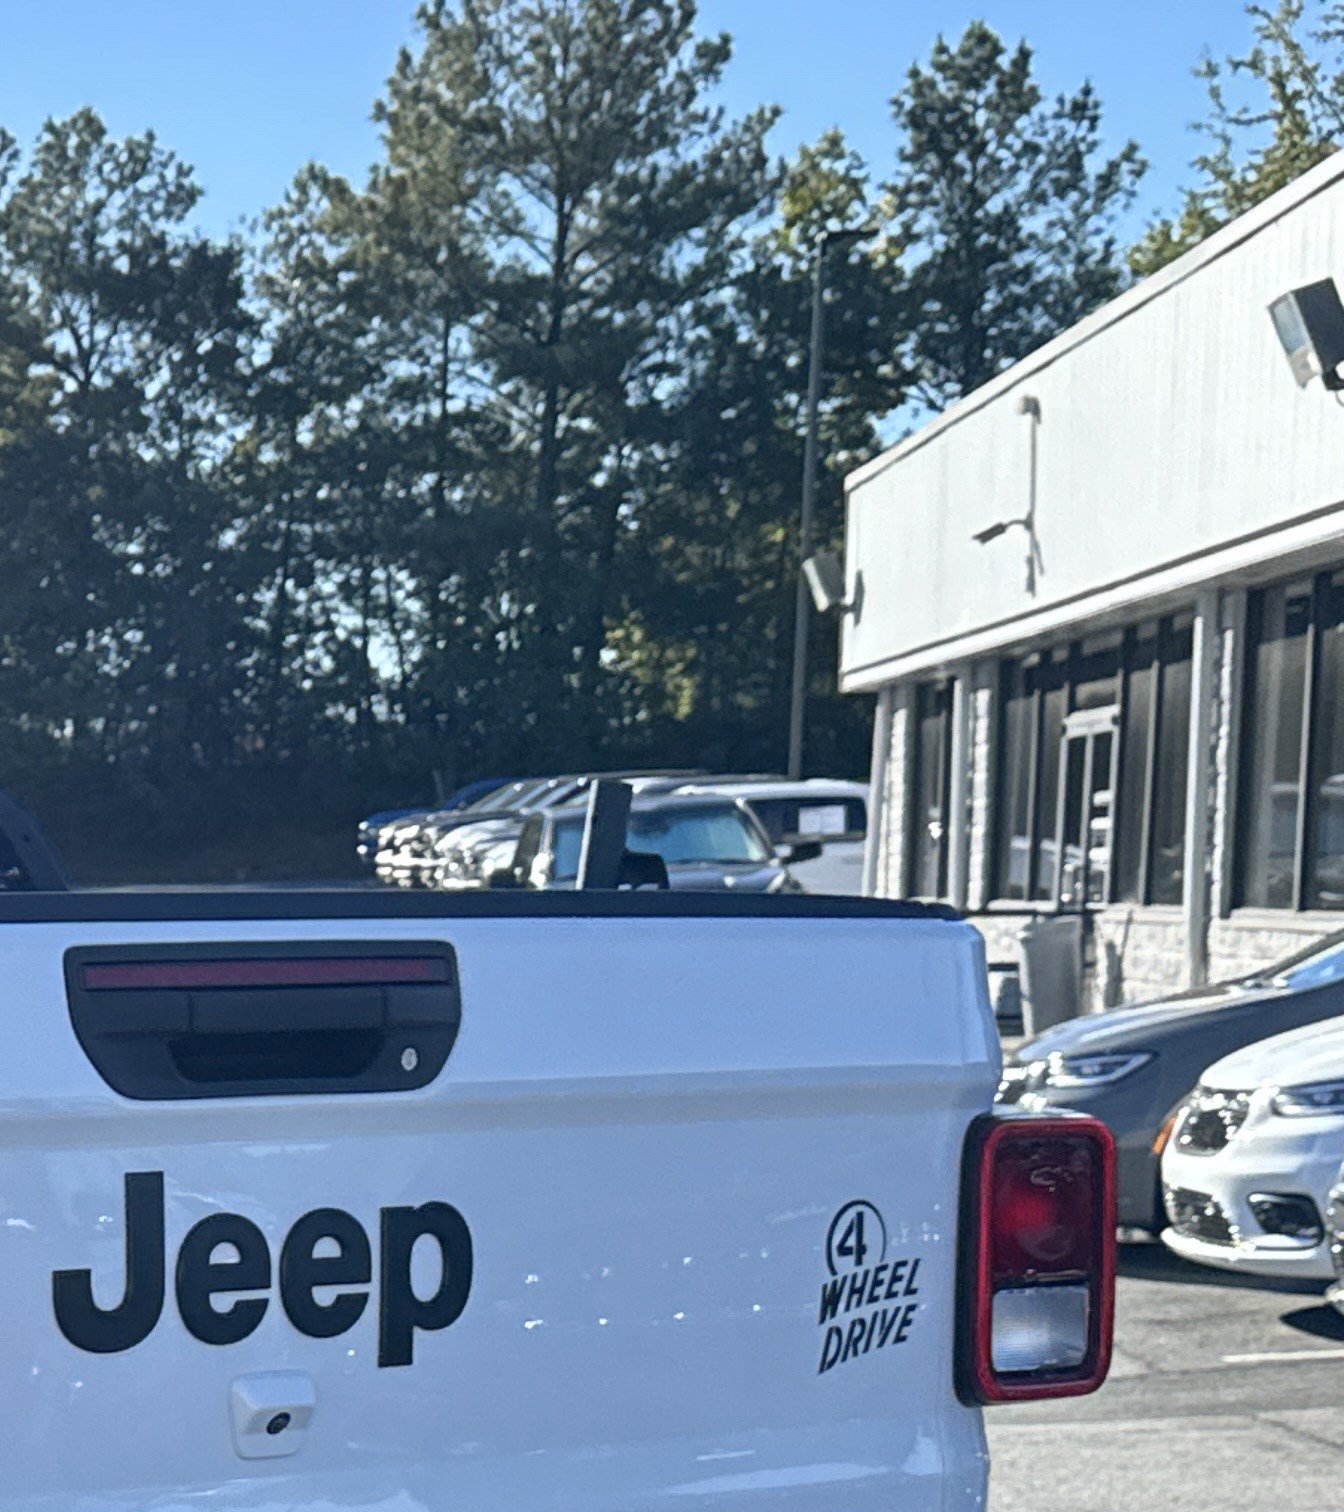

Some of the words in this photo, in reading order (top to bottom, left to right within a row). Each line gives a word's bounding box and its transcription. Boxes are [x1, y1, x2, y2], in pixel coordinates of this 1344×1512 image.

[52, 1171, 474, 1368] Jeep
[836, 1210, 868, 1267] 4
[818, 1257, 922, 1327] WHEEL
[817, 1302, 919, 1376] DRIVE
